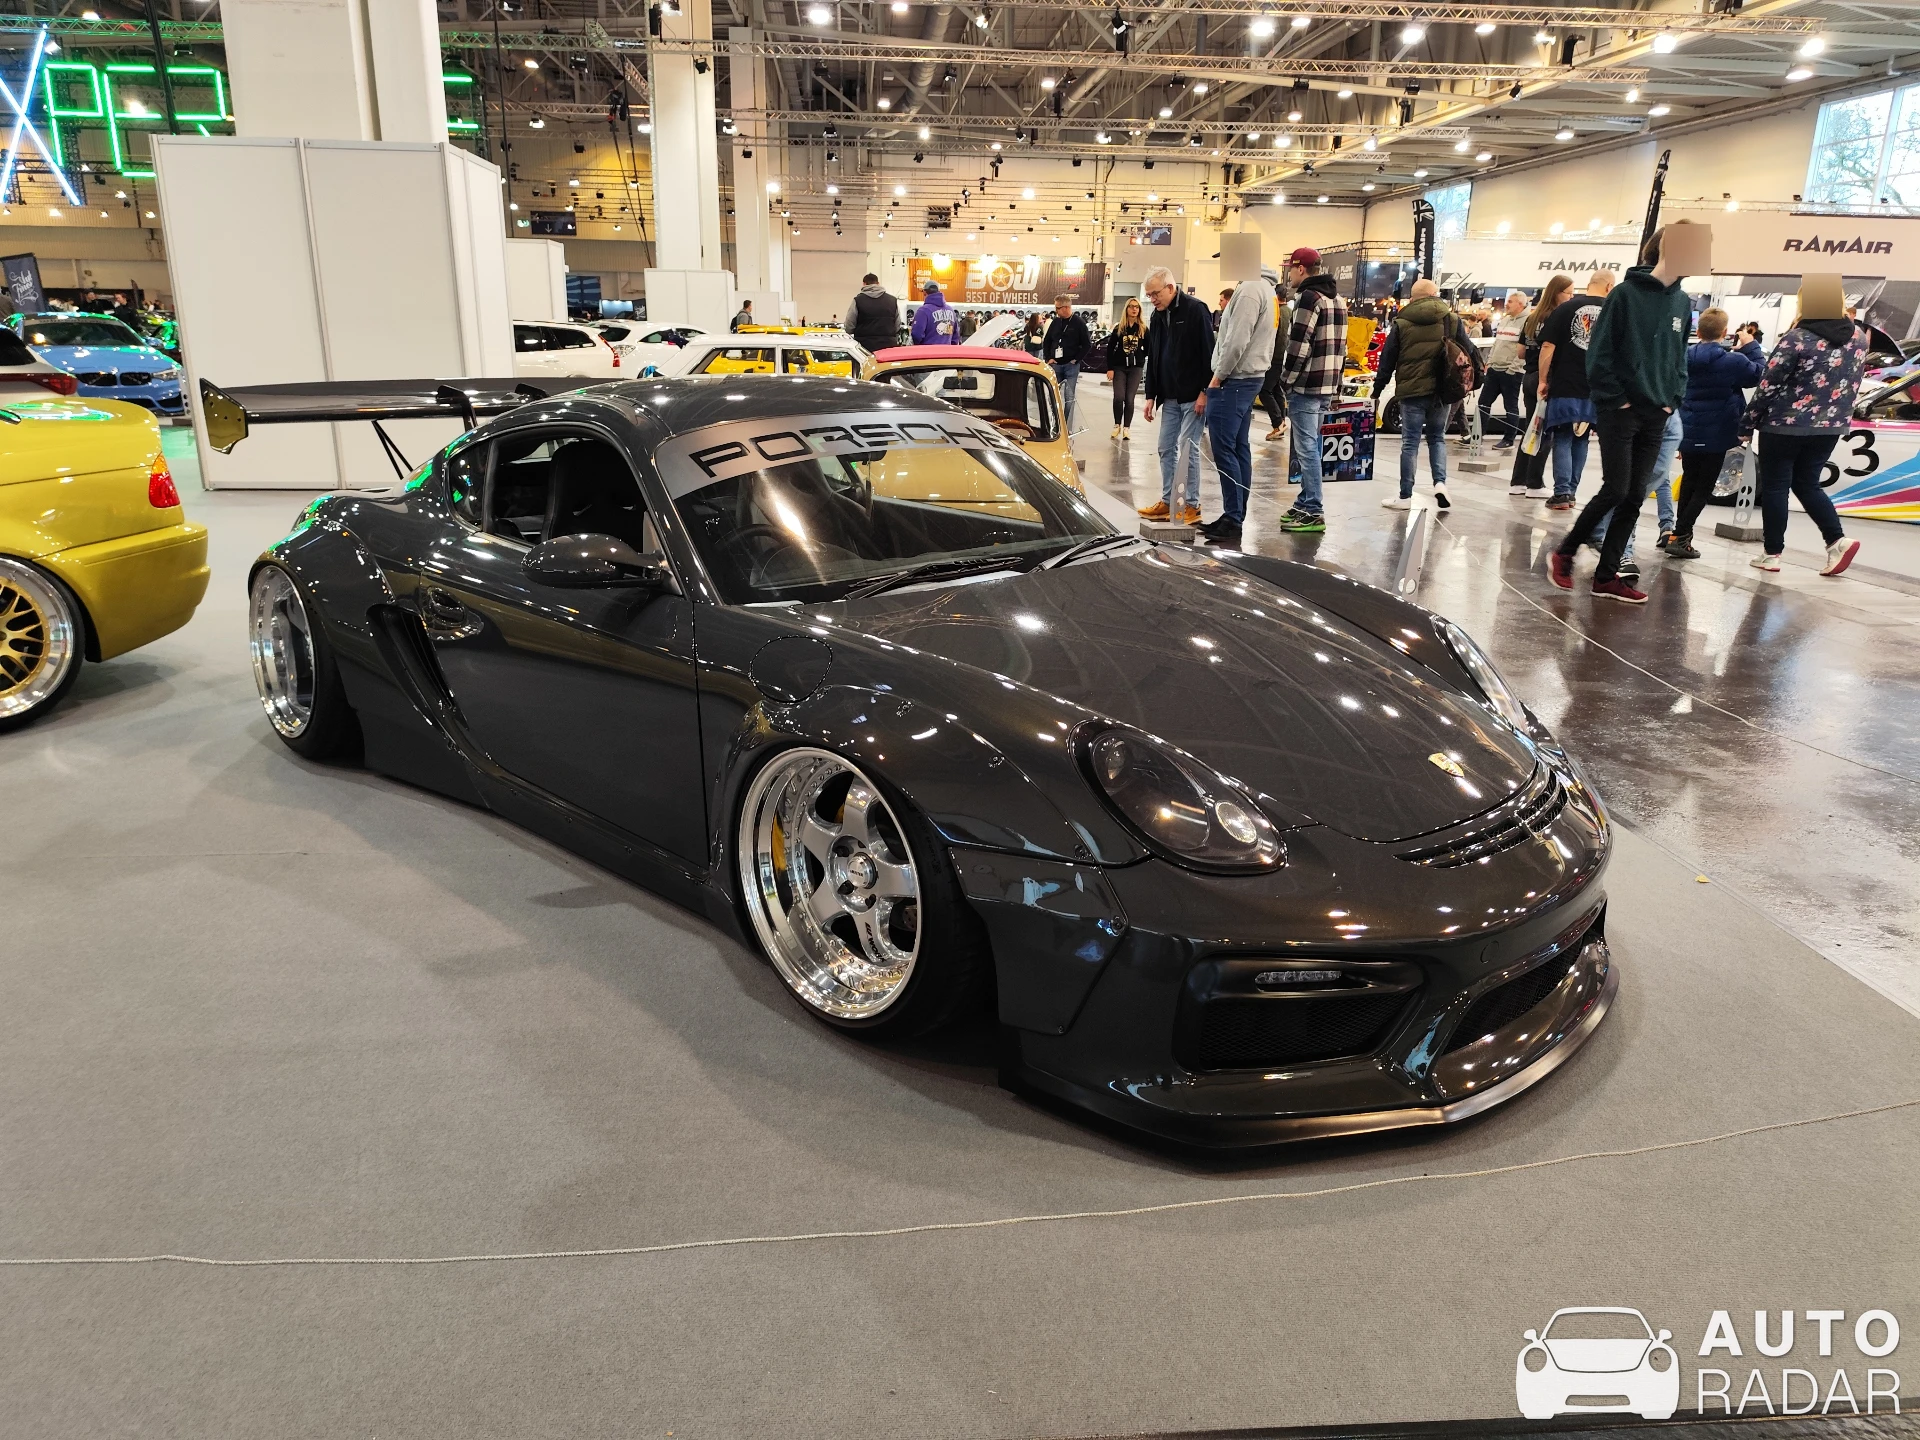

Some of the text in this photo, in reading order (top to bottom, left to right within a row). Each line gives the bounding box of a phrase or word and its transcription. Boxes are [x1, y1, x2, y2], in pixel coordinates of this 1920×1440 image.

[1782, 235, 1894, 257] RAMAIR
[1538, 258, 1622, 274] RAMAIR
[966, 291, 1038, 304] BEST OF WHEELS
[688, 423, 1019, 478] PORSCHE
